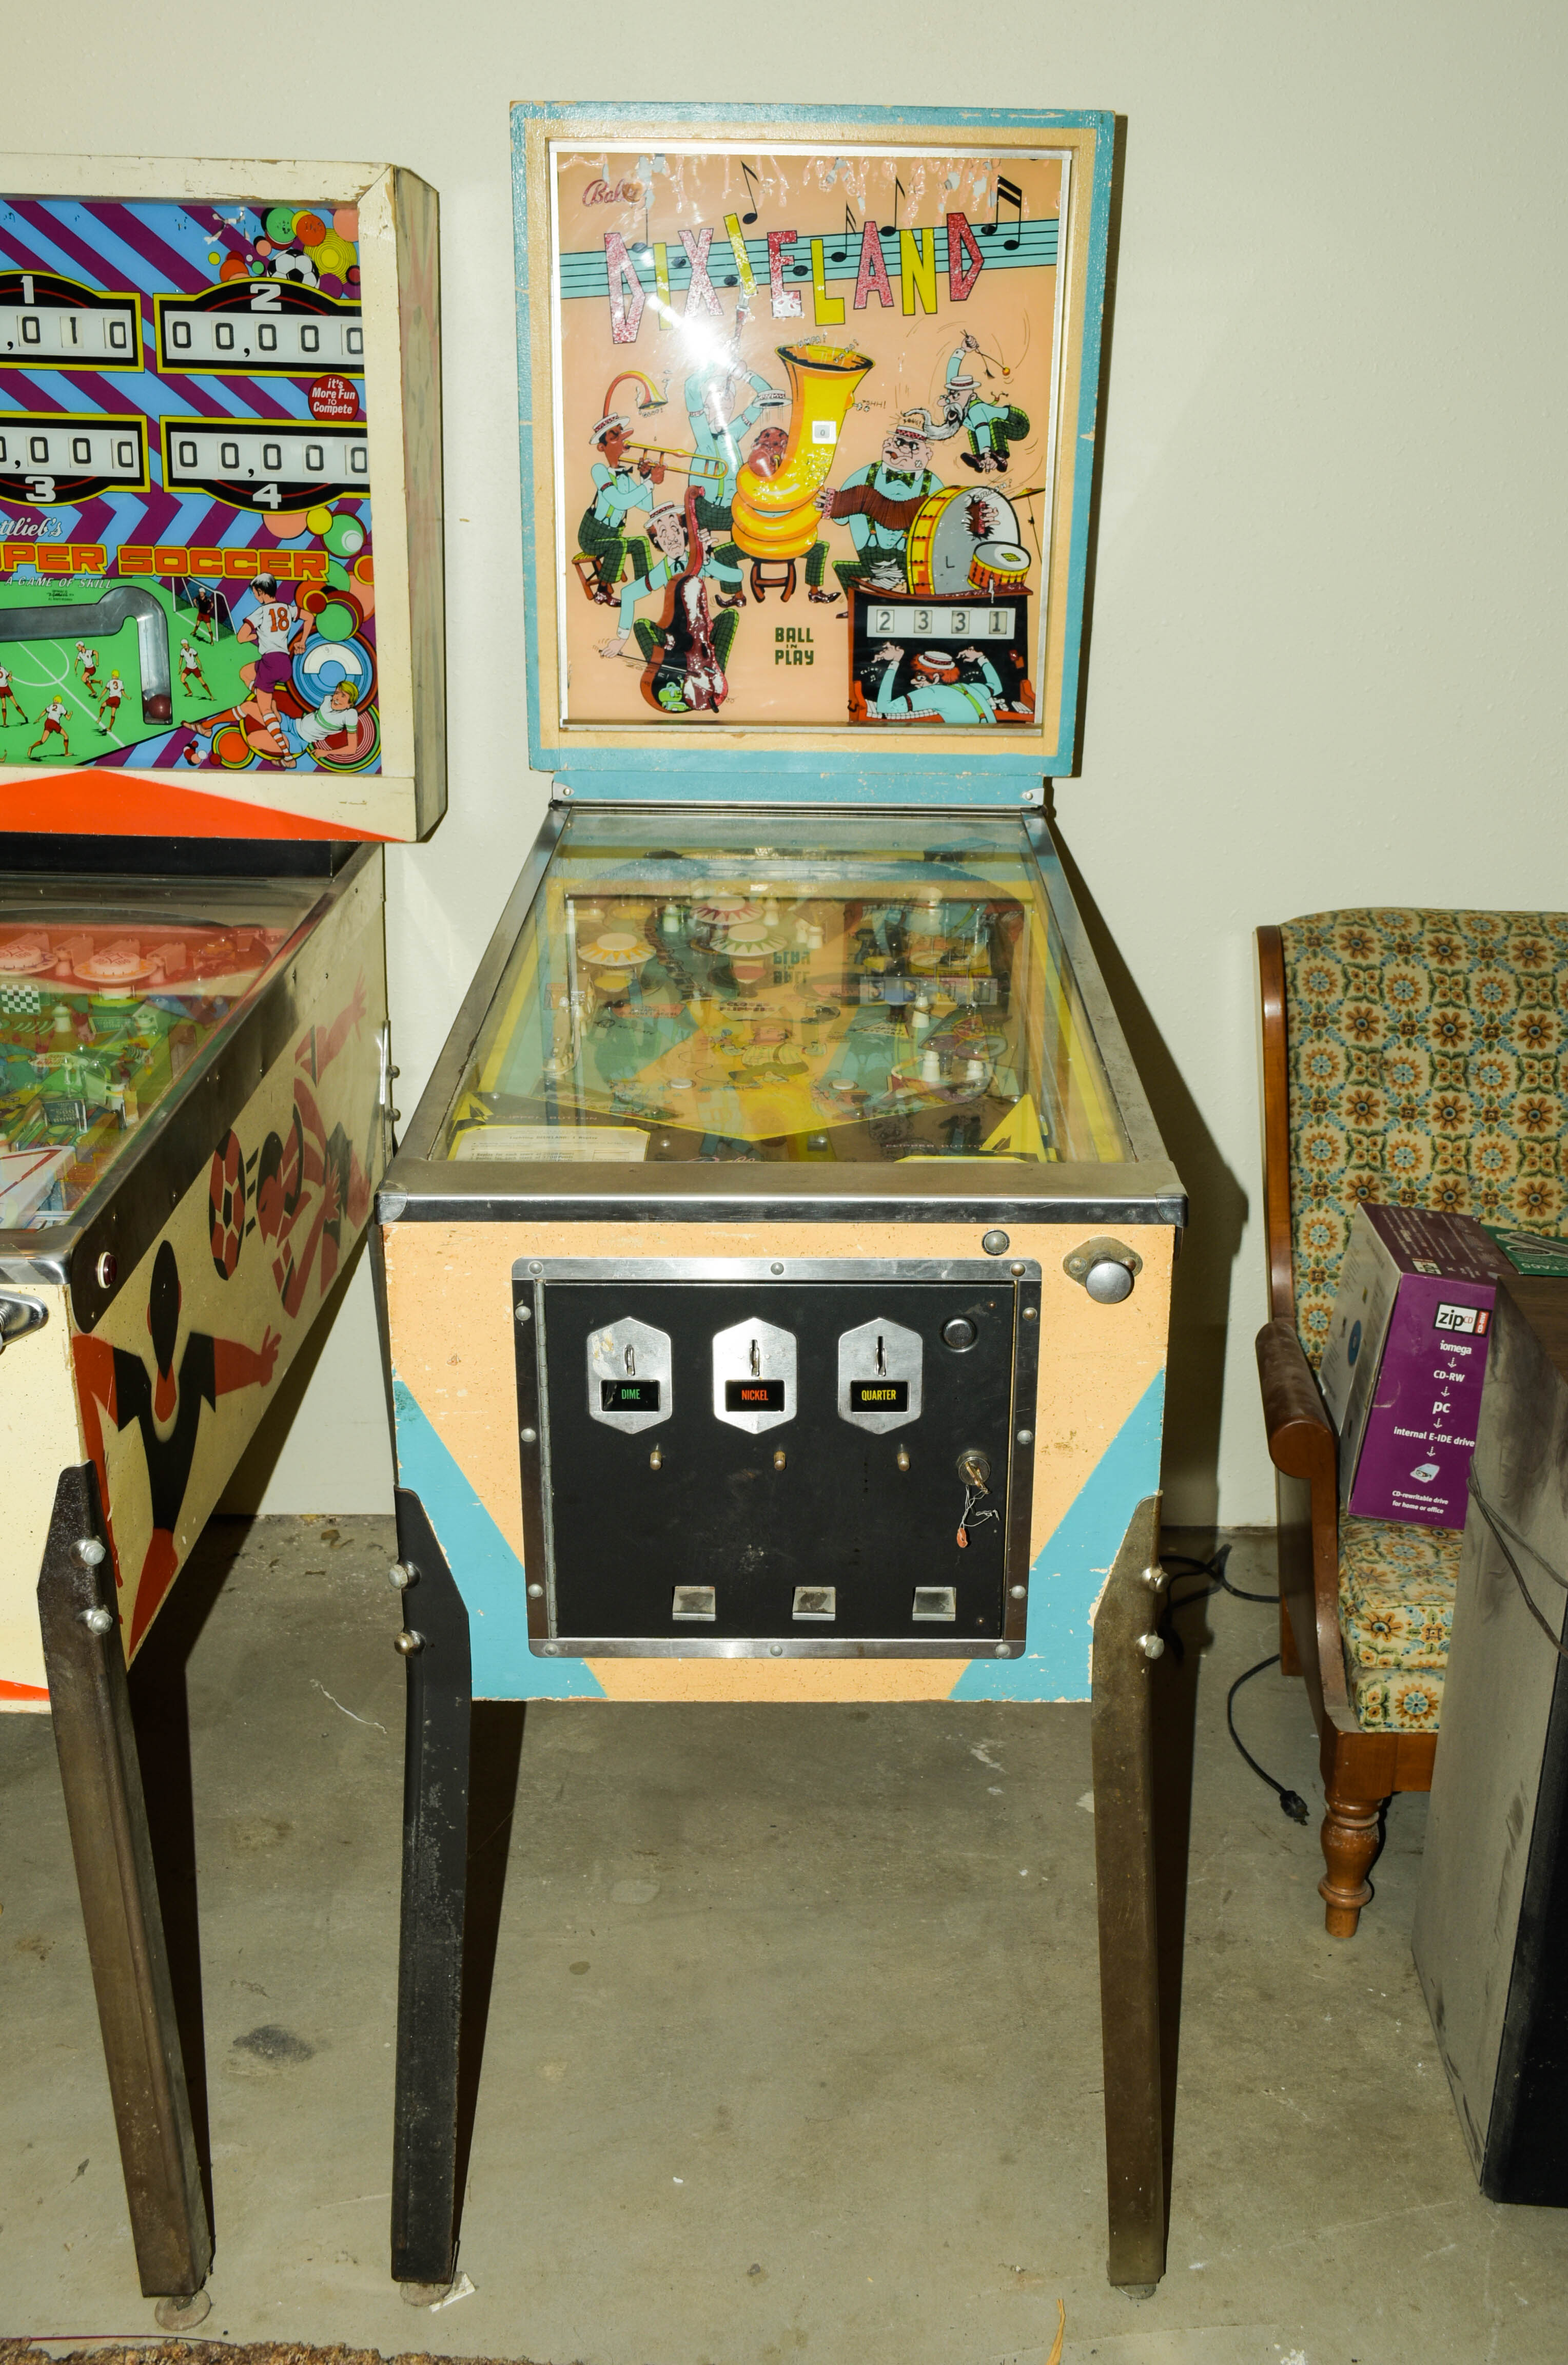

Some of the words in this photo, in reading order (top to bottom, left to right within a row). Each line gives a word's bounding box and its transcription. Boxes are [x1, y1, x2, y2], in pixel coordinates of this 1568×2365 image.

[604, 212, 984, 344] DIXIELAND
[21, 276, 34, 304] 1
[250, 284, 282, 311] 2
[328, 378, 343, 389] it's
[312, 387, 336, 398] More
[338, 389, 355, 399] Fun
[313, 401, 352, 415] Compete
[25, 476, 56, 502] 3
[252, 483, 282, 510] 4
[0, 542, 107, 574] PER
[118, 546, 328, 580] SOCCER
[5, 576, 13, 586] A
[18, 577, 53, 587] GAME
[58, 578, 75, 587] OF
[79, 578, 111, 589] SKILL
[268, 607, 289, 632] 18
[775, 628, 814, 643] BALL
[775, 650, 814, 665] PLAY
[112, 681, 119, 690] 3
[1478, 1312, 1486, 1333] CD-RW
[1440, 1340, 1472, 1355] iomega
[1434, 1370, 1465, 1382] CD-RW
[621, 1389, 641, 1400] DIME
[741, 1389, 769, 1401] NICKEL
[861, 1389, 896, 1401] QUARTER
[1433, 1402, 1451, 1414] pc
[1394, 1426, 1427, 1439] internal
[1428, 1432, 1453, 1443] E-IDE
[1454, 1437, 1475, 1447] drive
[1392, 1490, 1433, 1502] CD-rewritable
